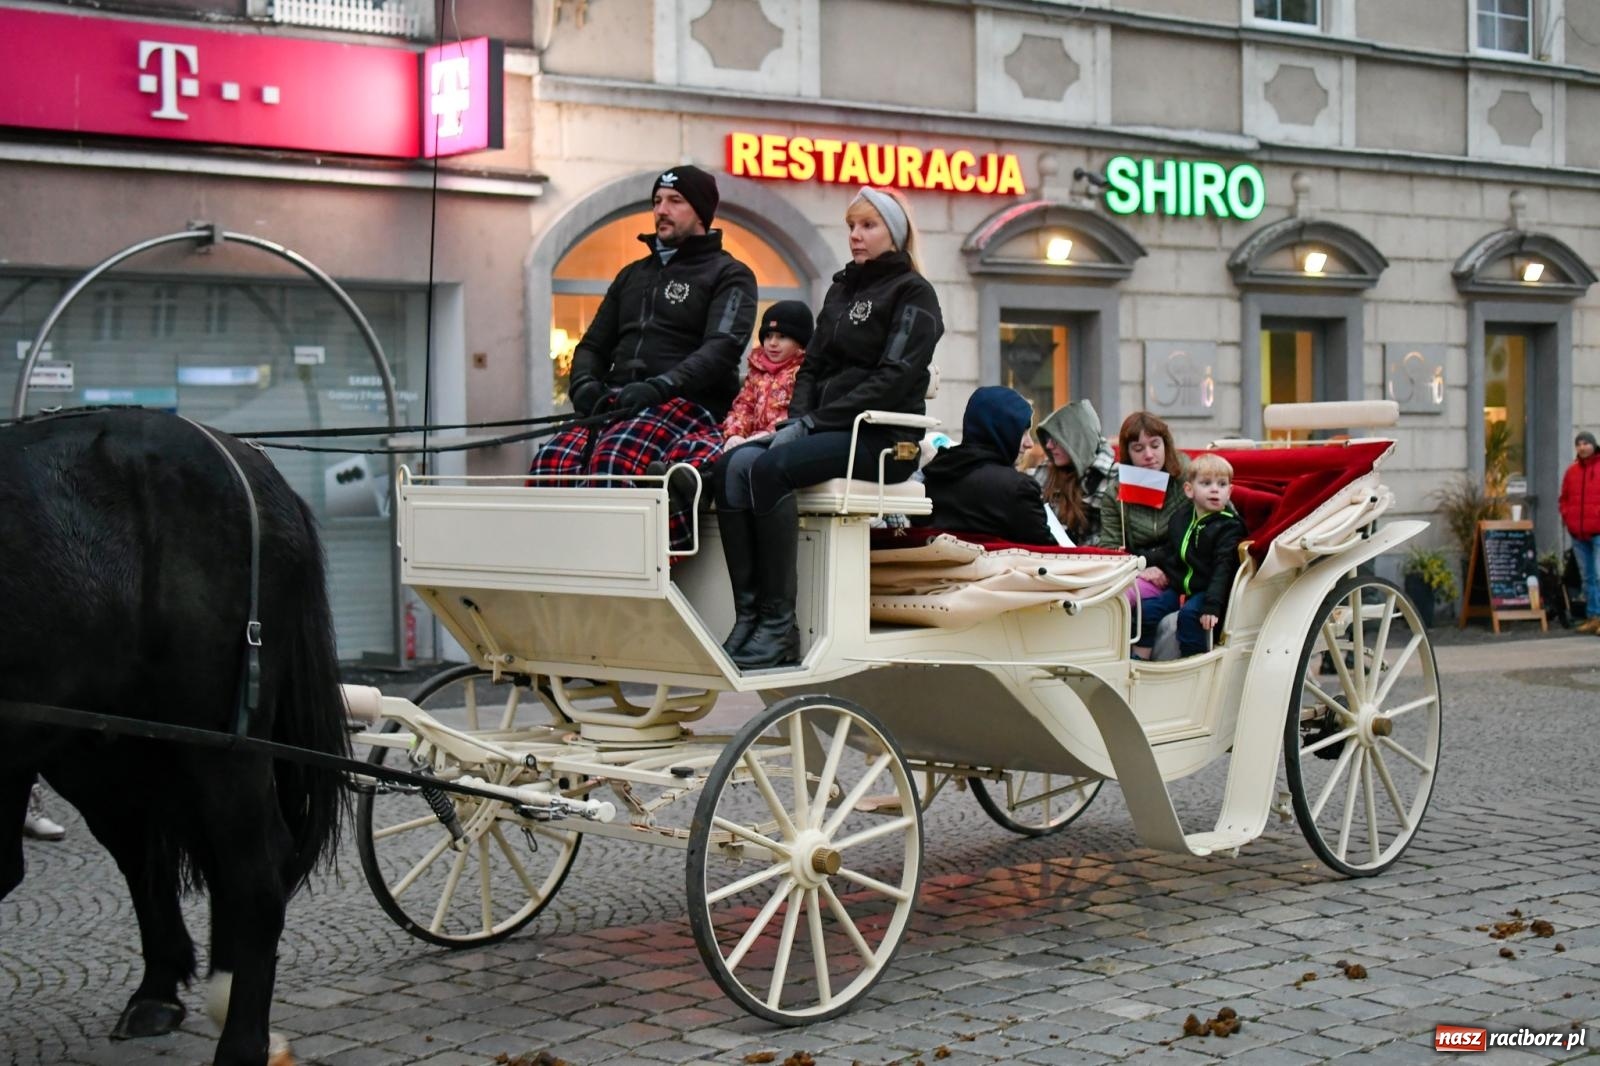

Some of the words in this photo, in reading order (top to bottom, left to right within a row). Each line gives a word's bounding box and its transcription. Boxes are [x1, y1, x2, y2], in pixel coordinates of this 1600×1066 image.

[431, 57, 470, 137] T
[729, 131, 1025, 195] RESTAURACJA
[1106, 156, 1265, 220] SHIRO
